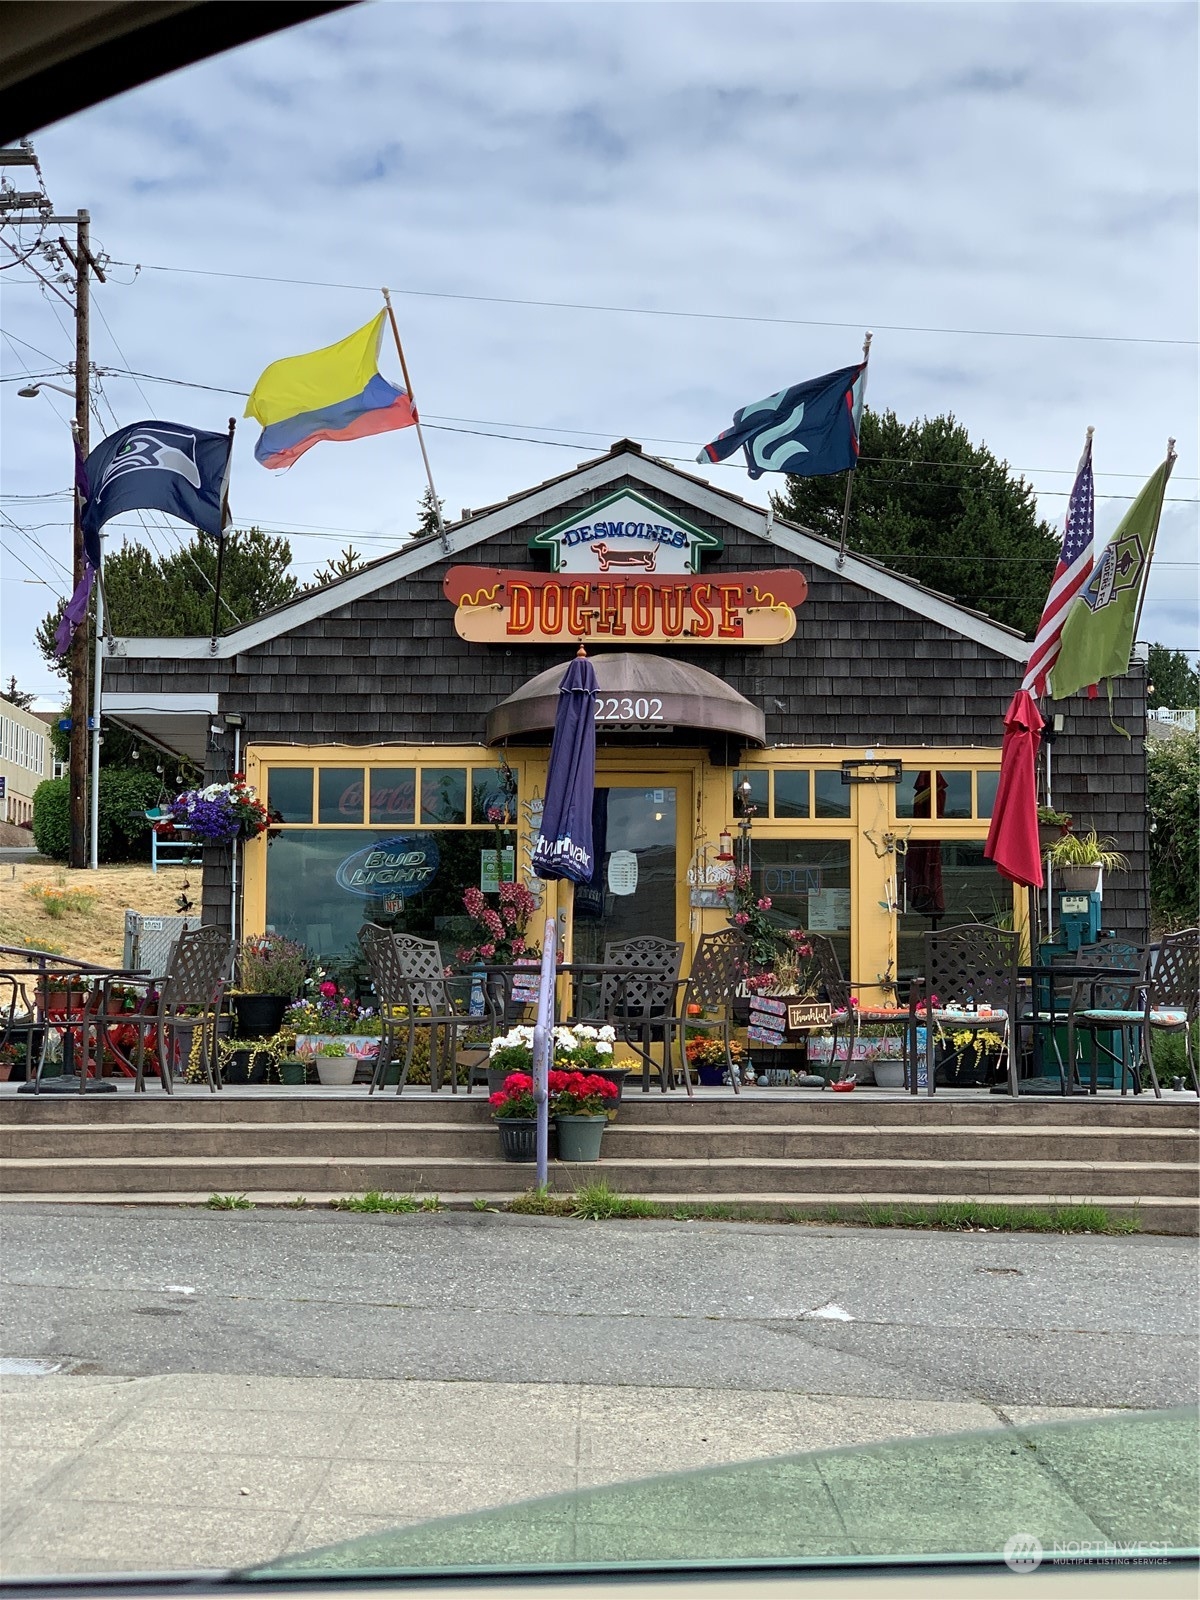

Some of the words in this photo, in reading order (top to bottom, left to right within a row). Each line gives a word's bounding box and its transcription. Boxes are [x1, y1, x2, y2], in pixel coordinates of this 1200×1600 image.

[506, 580, 744, 635] DOGHOUSE
[594, 698, 663, 720] 22302
[365, 851, 426, 869] BUD
[349, 867, 435, 886] LIGHT
[765, 869, 819, 893] OPEN
[385, 900, 401, 912] NFL
